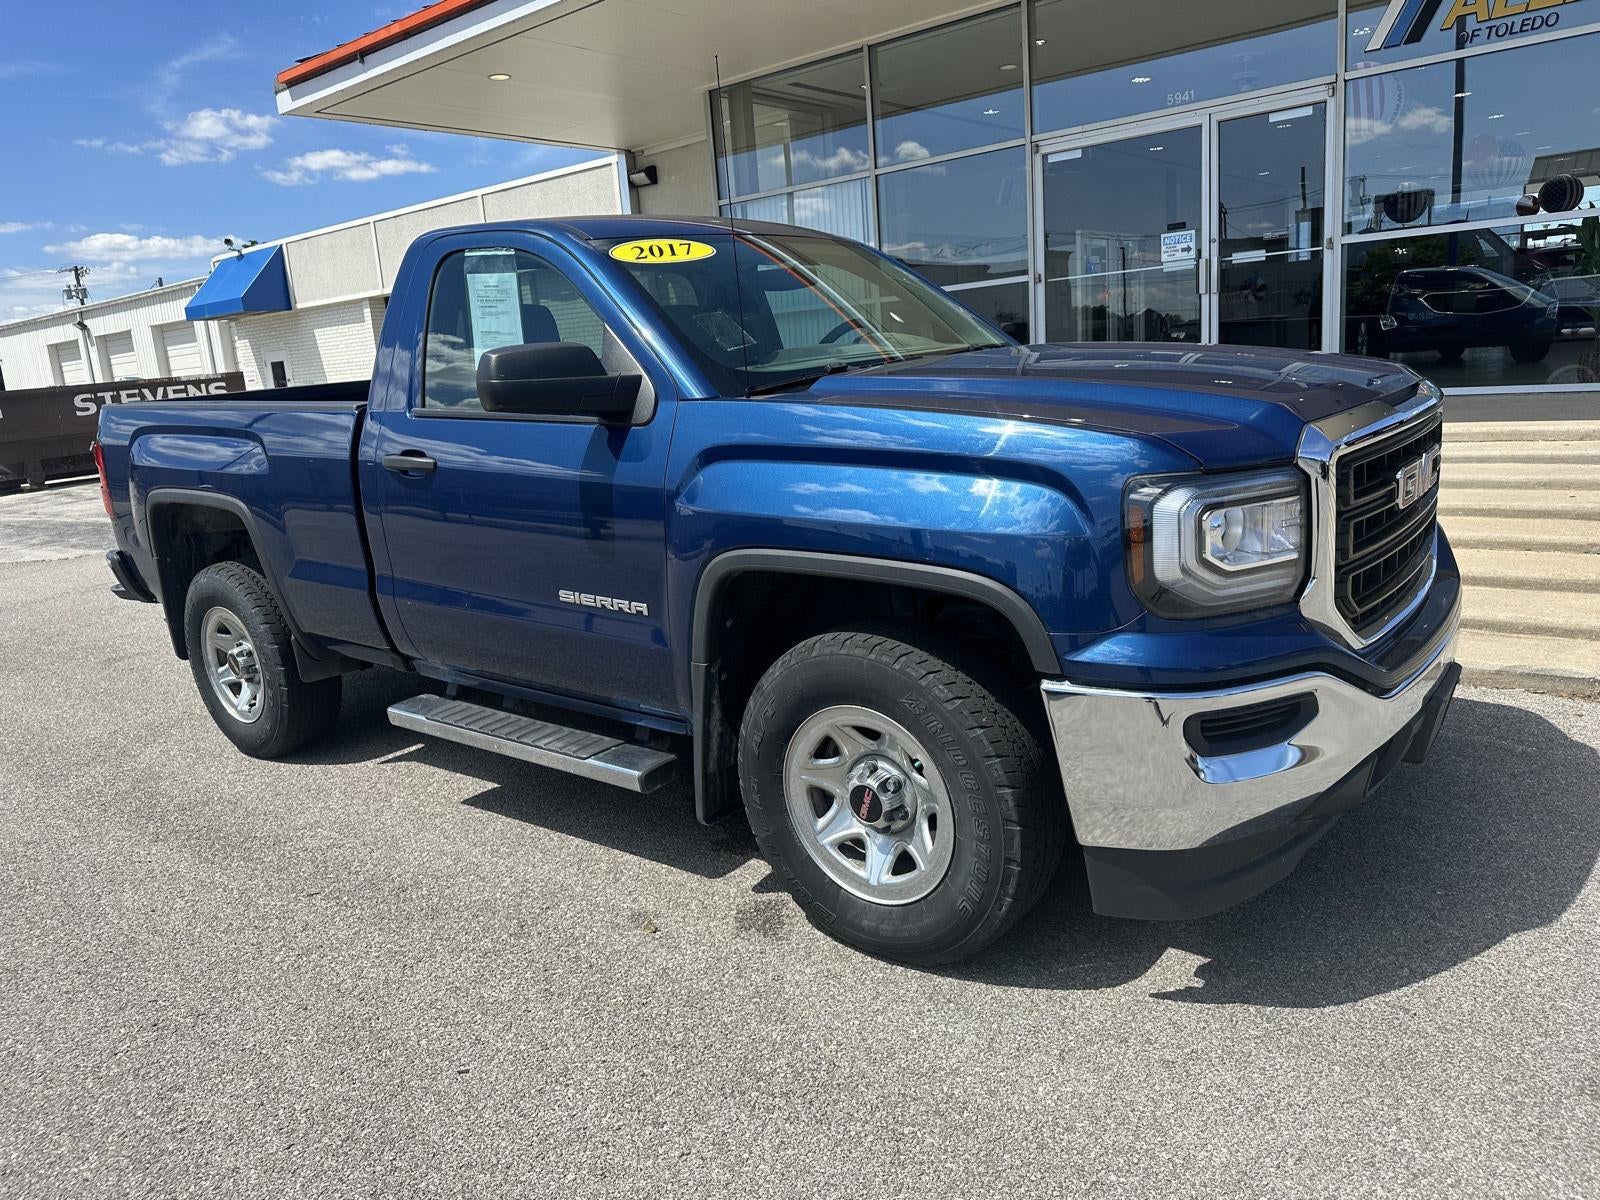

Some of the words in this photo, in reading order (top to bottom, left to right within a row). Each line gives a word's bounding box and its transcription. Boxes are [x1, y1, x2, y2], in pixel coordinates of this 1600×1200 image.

[1458, 28, 1481, 44] OF
[1486, 12, 1560, 40] TOLEDO
[1167, 90, 1194, 105] 5941
[631, 243, 692, 261] 2017
[1163, 234, 1192, 245] NOTICE
[73, 381, 227, 416] STEVENS
[1397, 444, 1442, 509] GMC
[558, 590, 649, 616] SIERRA
[859, 788, 873, 819] GMC
[901, 692, 992, 920] BRIDGESTONE
